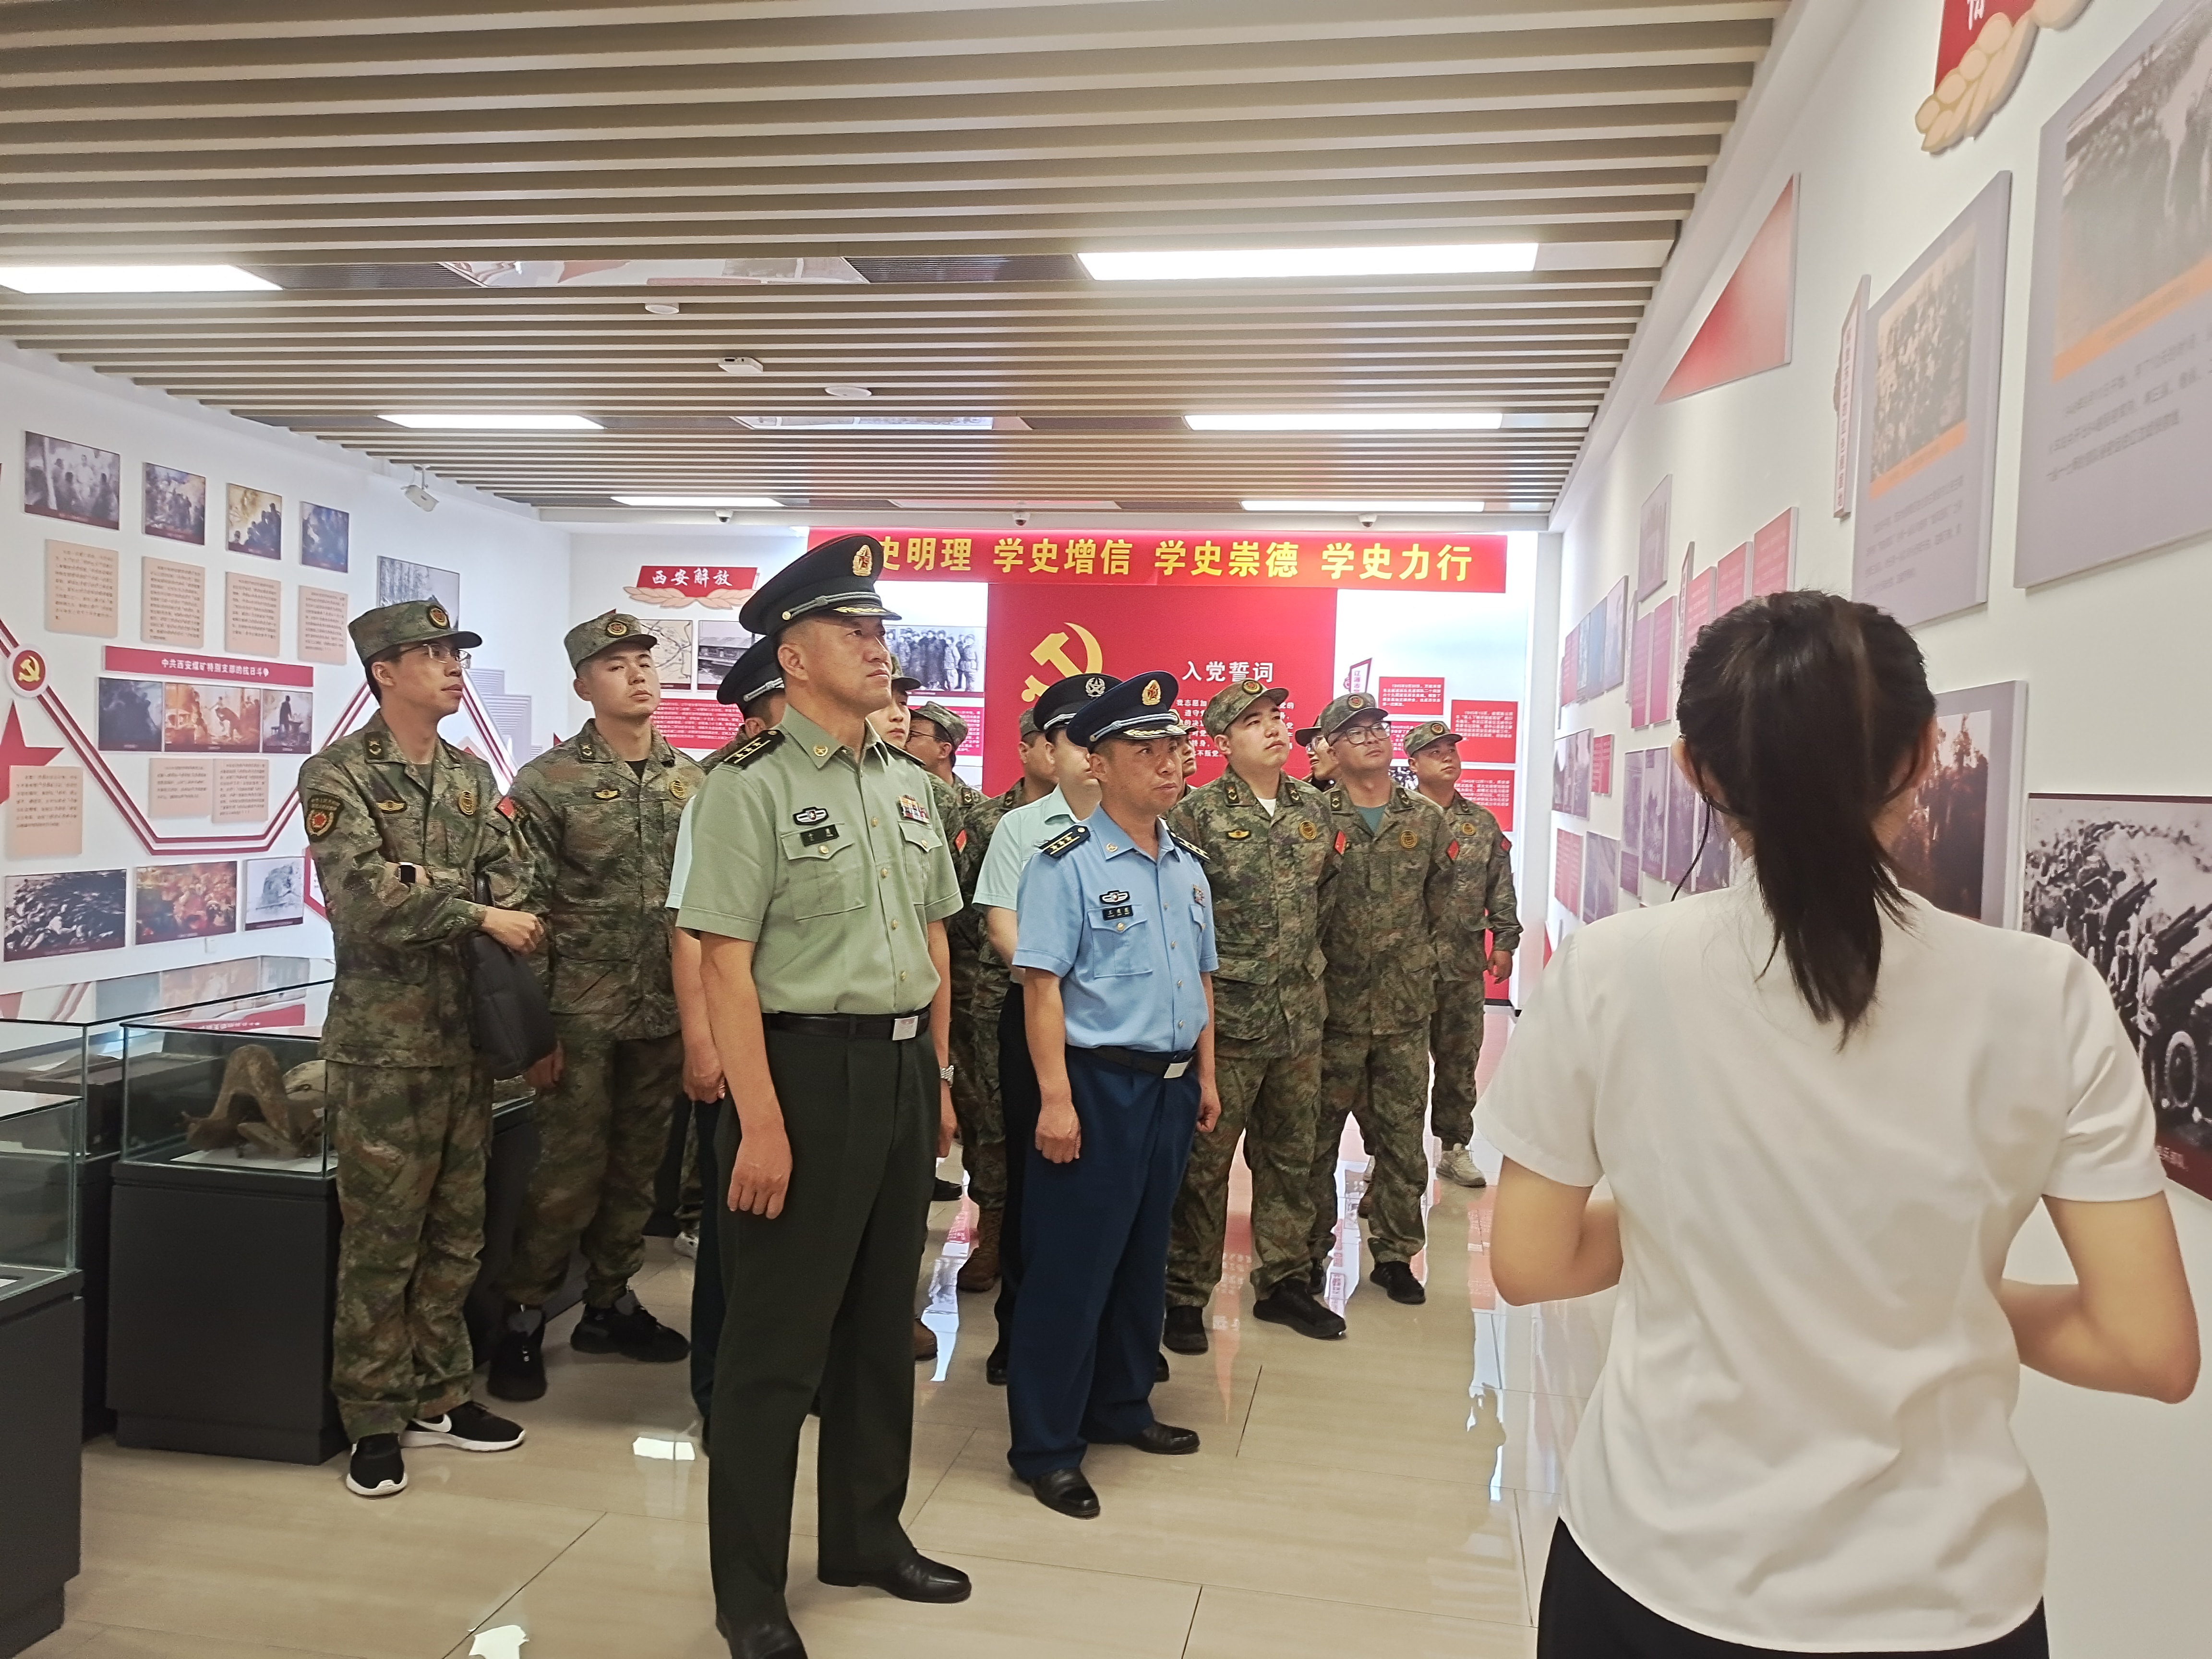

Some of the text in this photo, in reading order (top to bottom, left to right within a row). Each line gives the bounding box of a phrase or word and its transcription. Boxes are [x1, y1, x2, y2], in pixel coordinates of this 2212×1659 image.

[993, 537, 1133, 575] 学史增信
[1154, 540, 1299, 578] 学史崇德
[1321, 542, 1473, 582] 学史力行
[652, 567, 733, 588] 西安解放
[1181, 661, 1274, 683] 入党誓词
